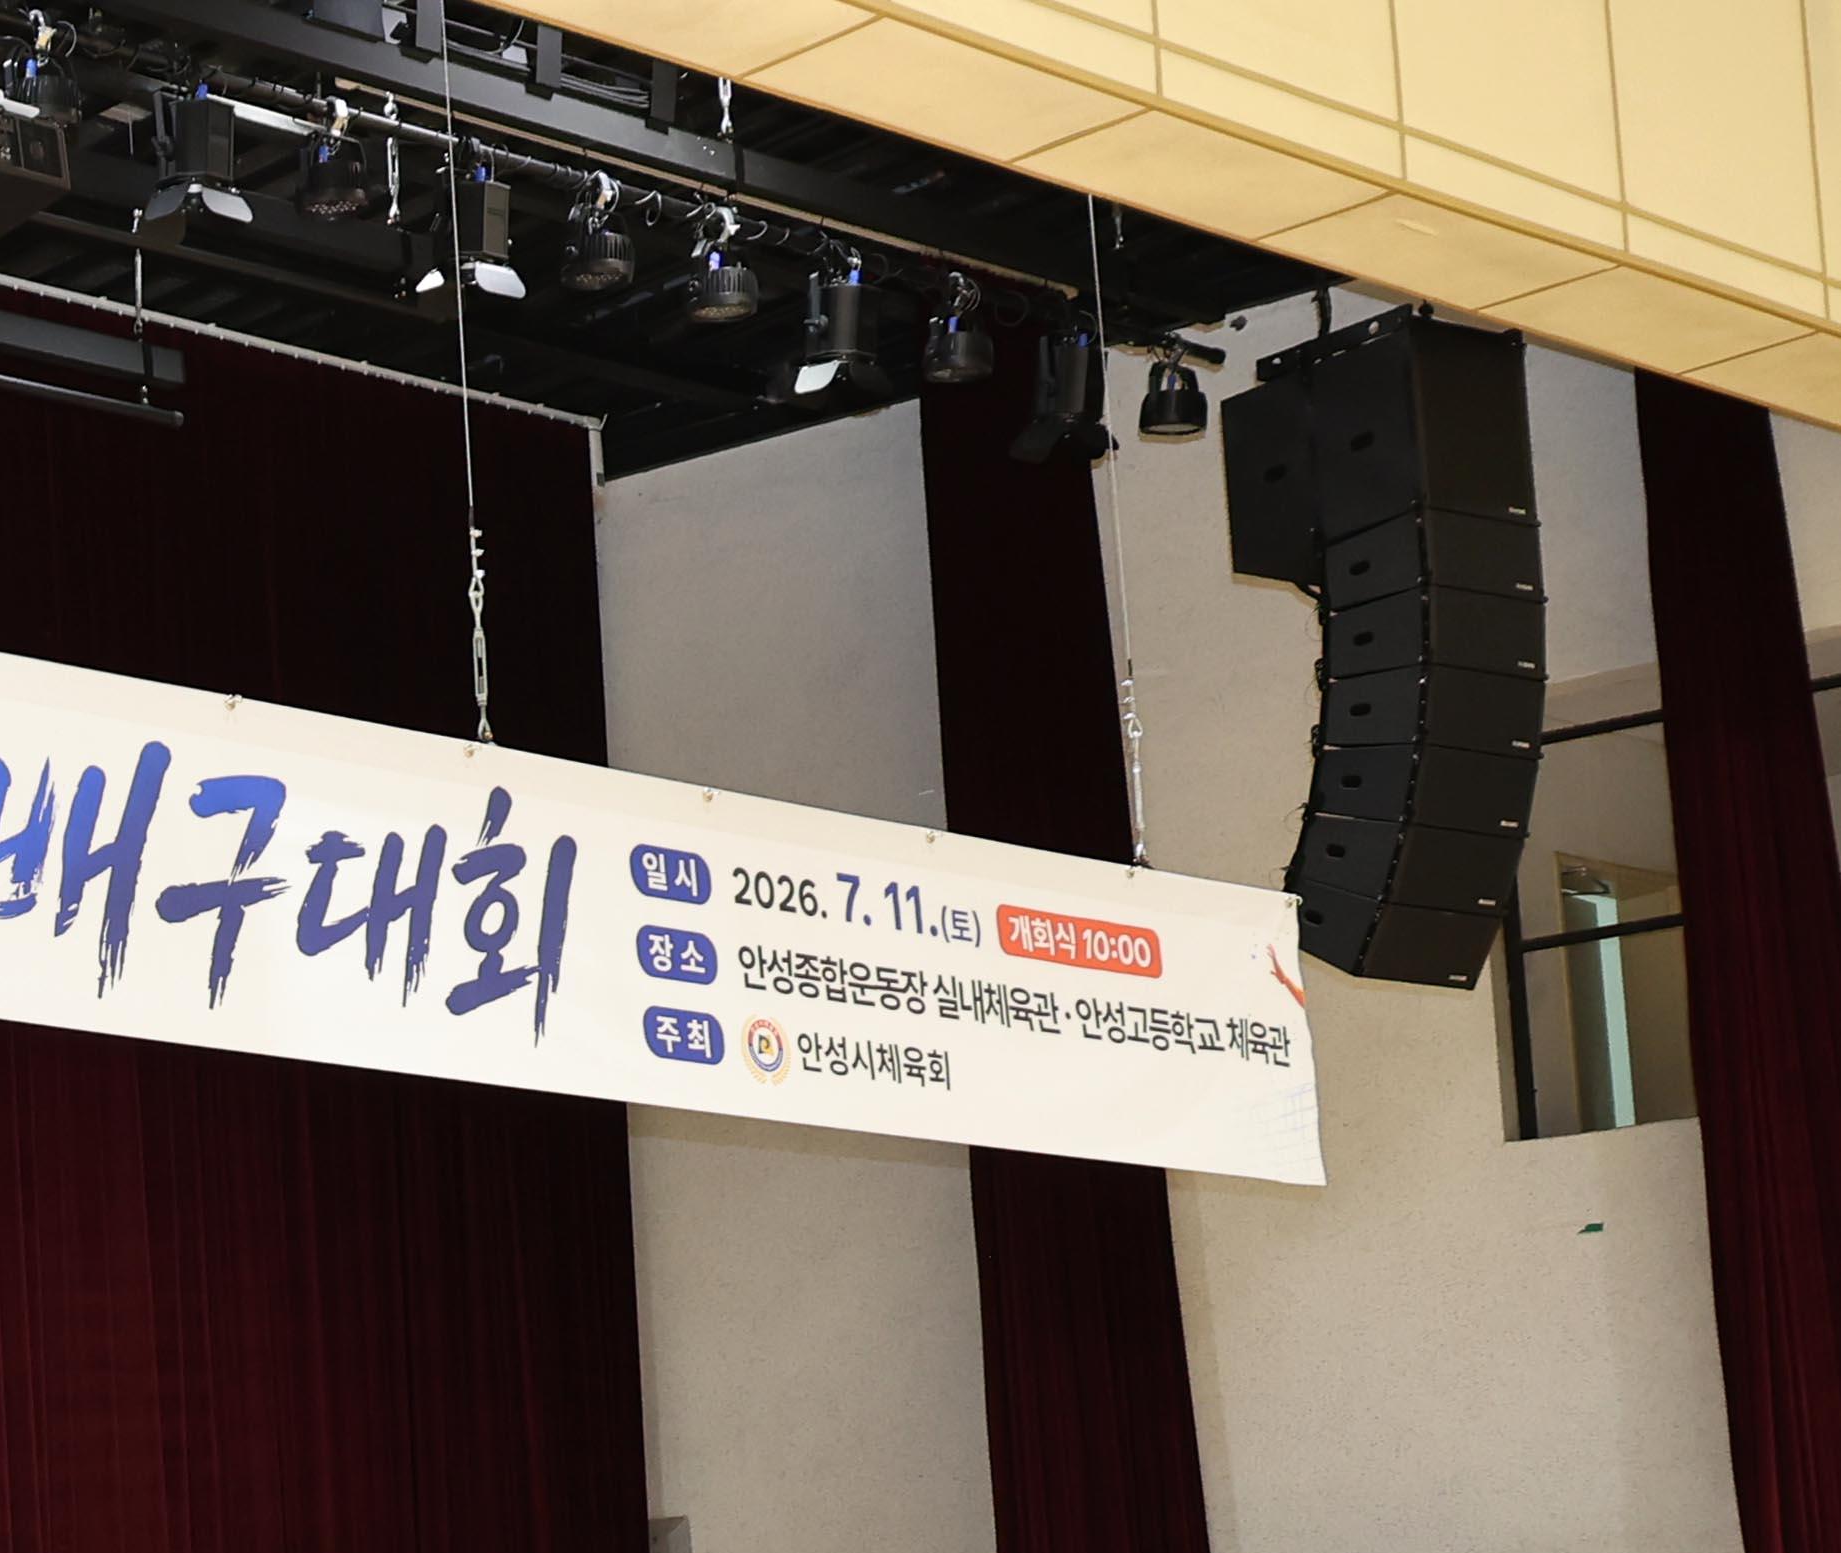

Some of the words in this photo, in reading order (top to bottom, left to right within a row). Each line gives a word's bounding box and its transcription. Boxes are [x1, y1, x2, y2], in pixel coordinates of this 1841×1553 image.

[732, 867, 828, 919] 2026.
[1007, 915, 1077, 960] 개회식
[1082, 929, 1152, 968] 10:00
[738, 945, 928, 1016] 안성종합운동장
[1227, 1017, 1292, 1068] 체육관
[797, 1031, 952, 1091] 안성시체육회
